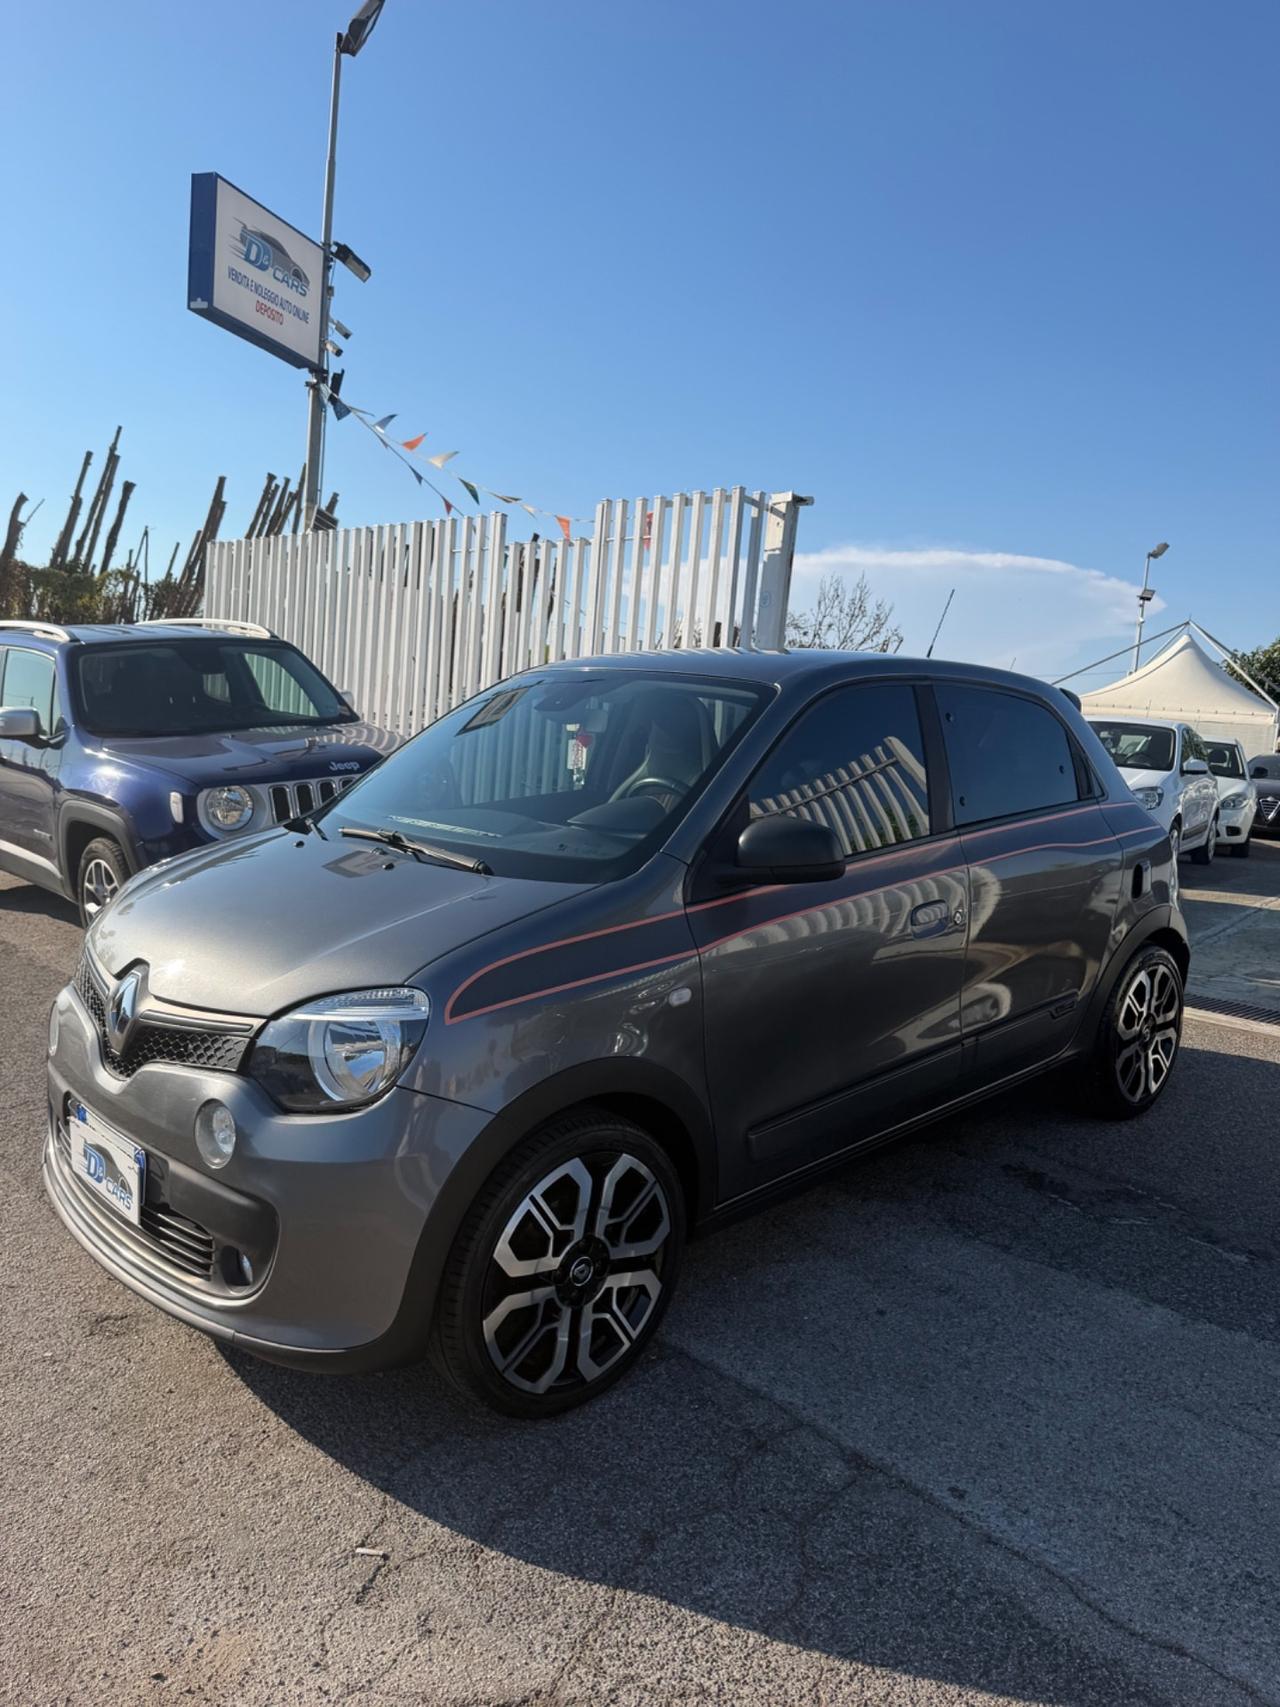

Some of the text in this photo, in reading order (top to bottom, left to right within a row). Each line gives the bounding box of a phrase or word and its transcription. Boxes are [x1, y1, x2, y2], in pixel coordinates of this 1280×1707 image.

[228, 266, 250, 290] VENDITA
[254, 282, 280, 307] NOLEGGIO
[280, 296, 293, 314] AUTO
[292, 304, 309, 324] ONLINE
[273, 266, 308, 297] CARS
[256, 299, 284, 325] DEPOSITO
[329, 761, 360, 771] Jeep
[106, 1176, 132, 1210] CARS
